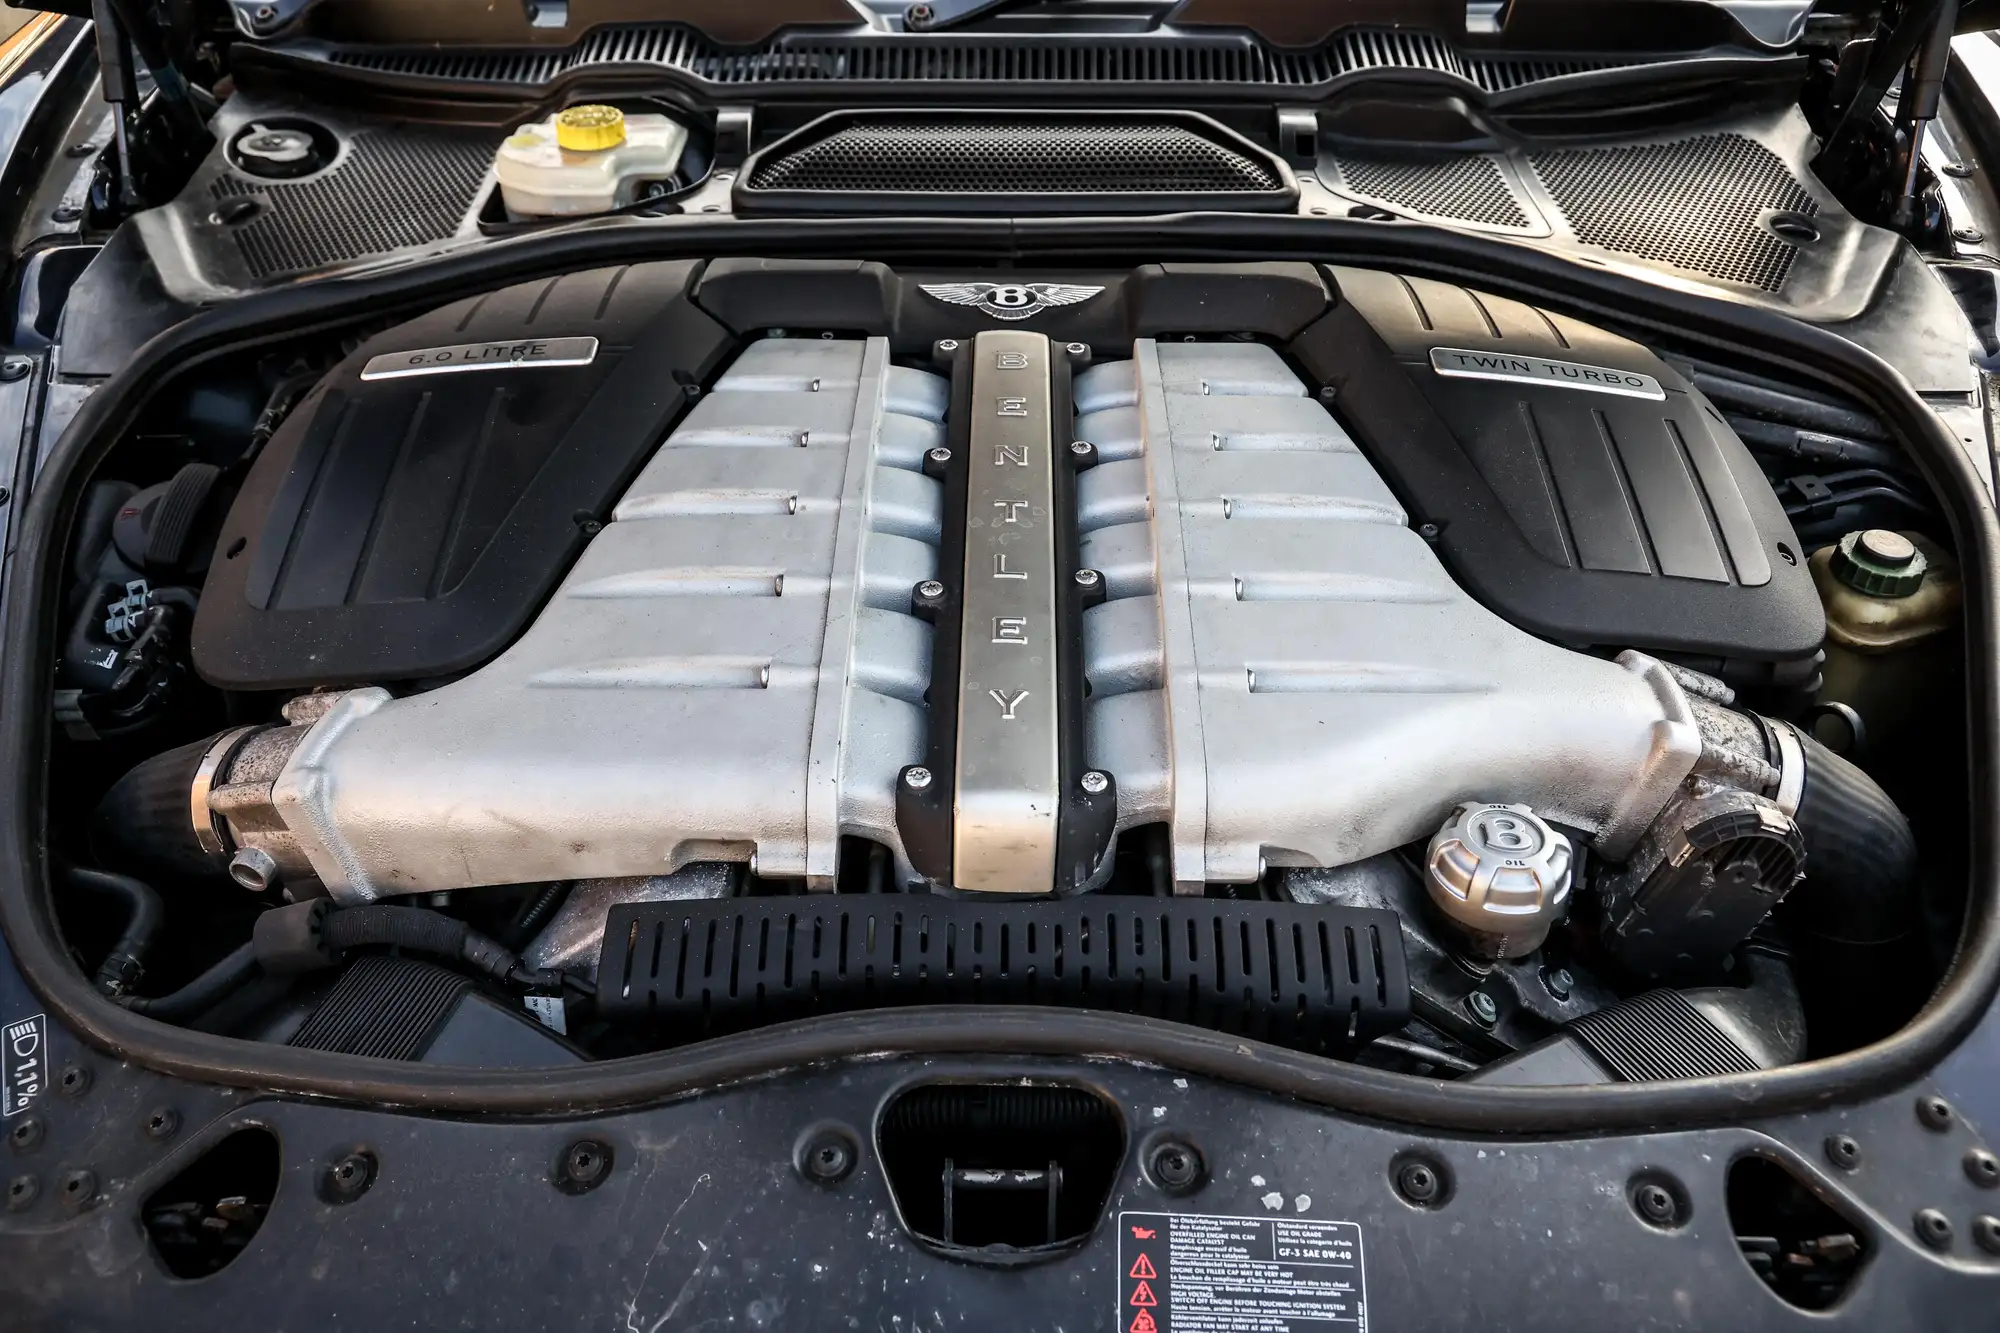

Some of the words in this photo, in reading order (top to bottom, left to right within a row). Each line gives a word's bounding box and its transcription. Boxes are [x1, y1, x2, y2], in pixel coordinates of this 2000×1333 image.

[994, 286, 1028, 306] B
[408, 351, 452, 365] 6.0
[464, 344, 547, 360] LITRE
[1452, 354, 1531, 372] TWIN
[1542, 364, 1644, 387] TURBO
[989, 351, 1029, 719] BENTLEY
[1505, 859, 1526, 867] OIL
[1278, 1247, 1300, 1257] GF-3
[1303, 1249, 1320, 1258] SAE
[1322, 1250, 1352, 1260] 0W-40
